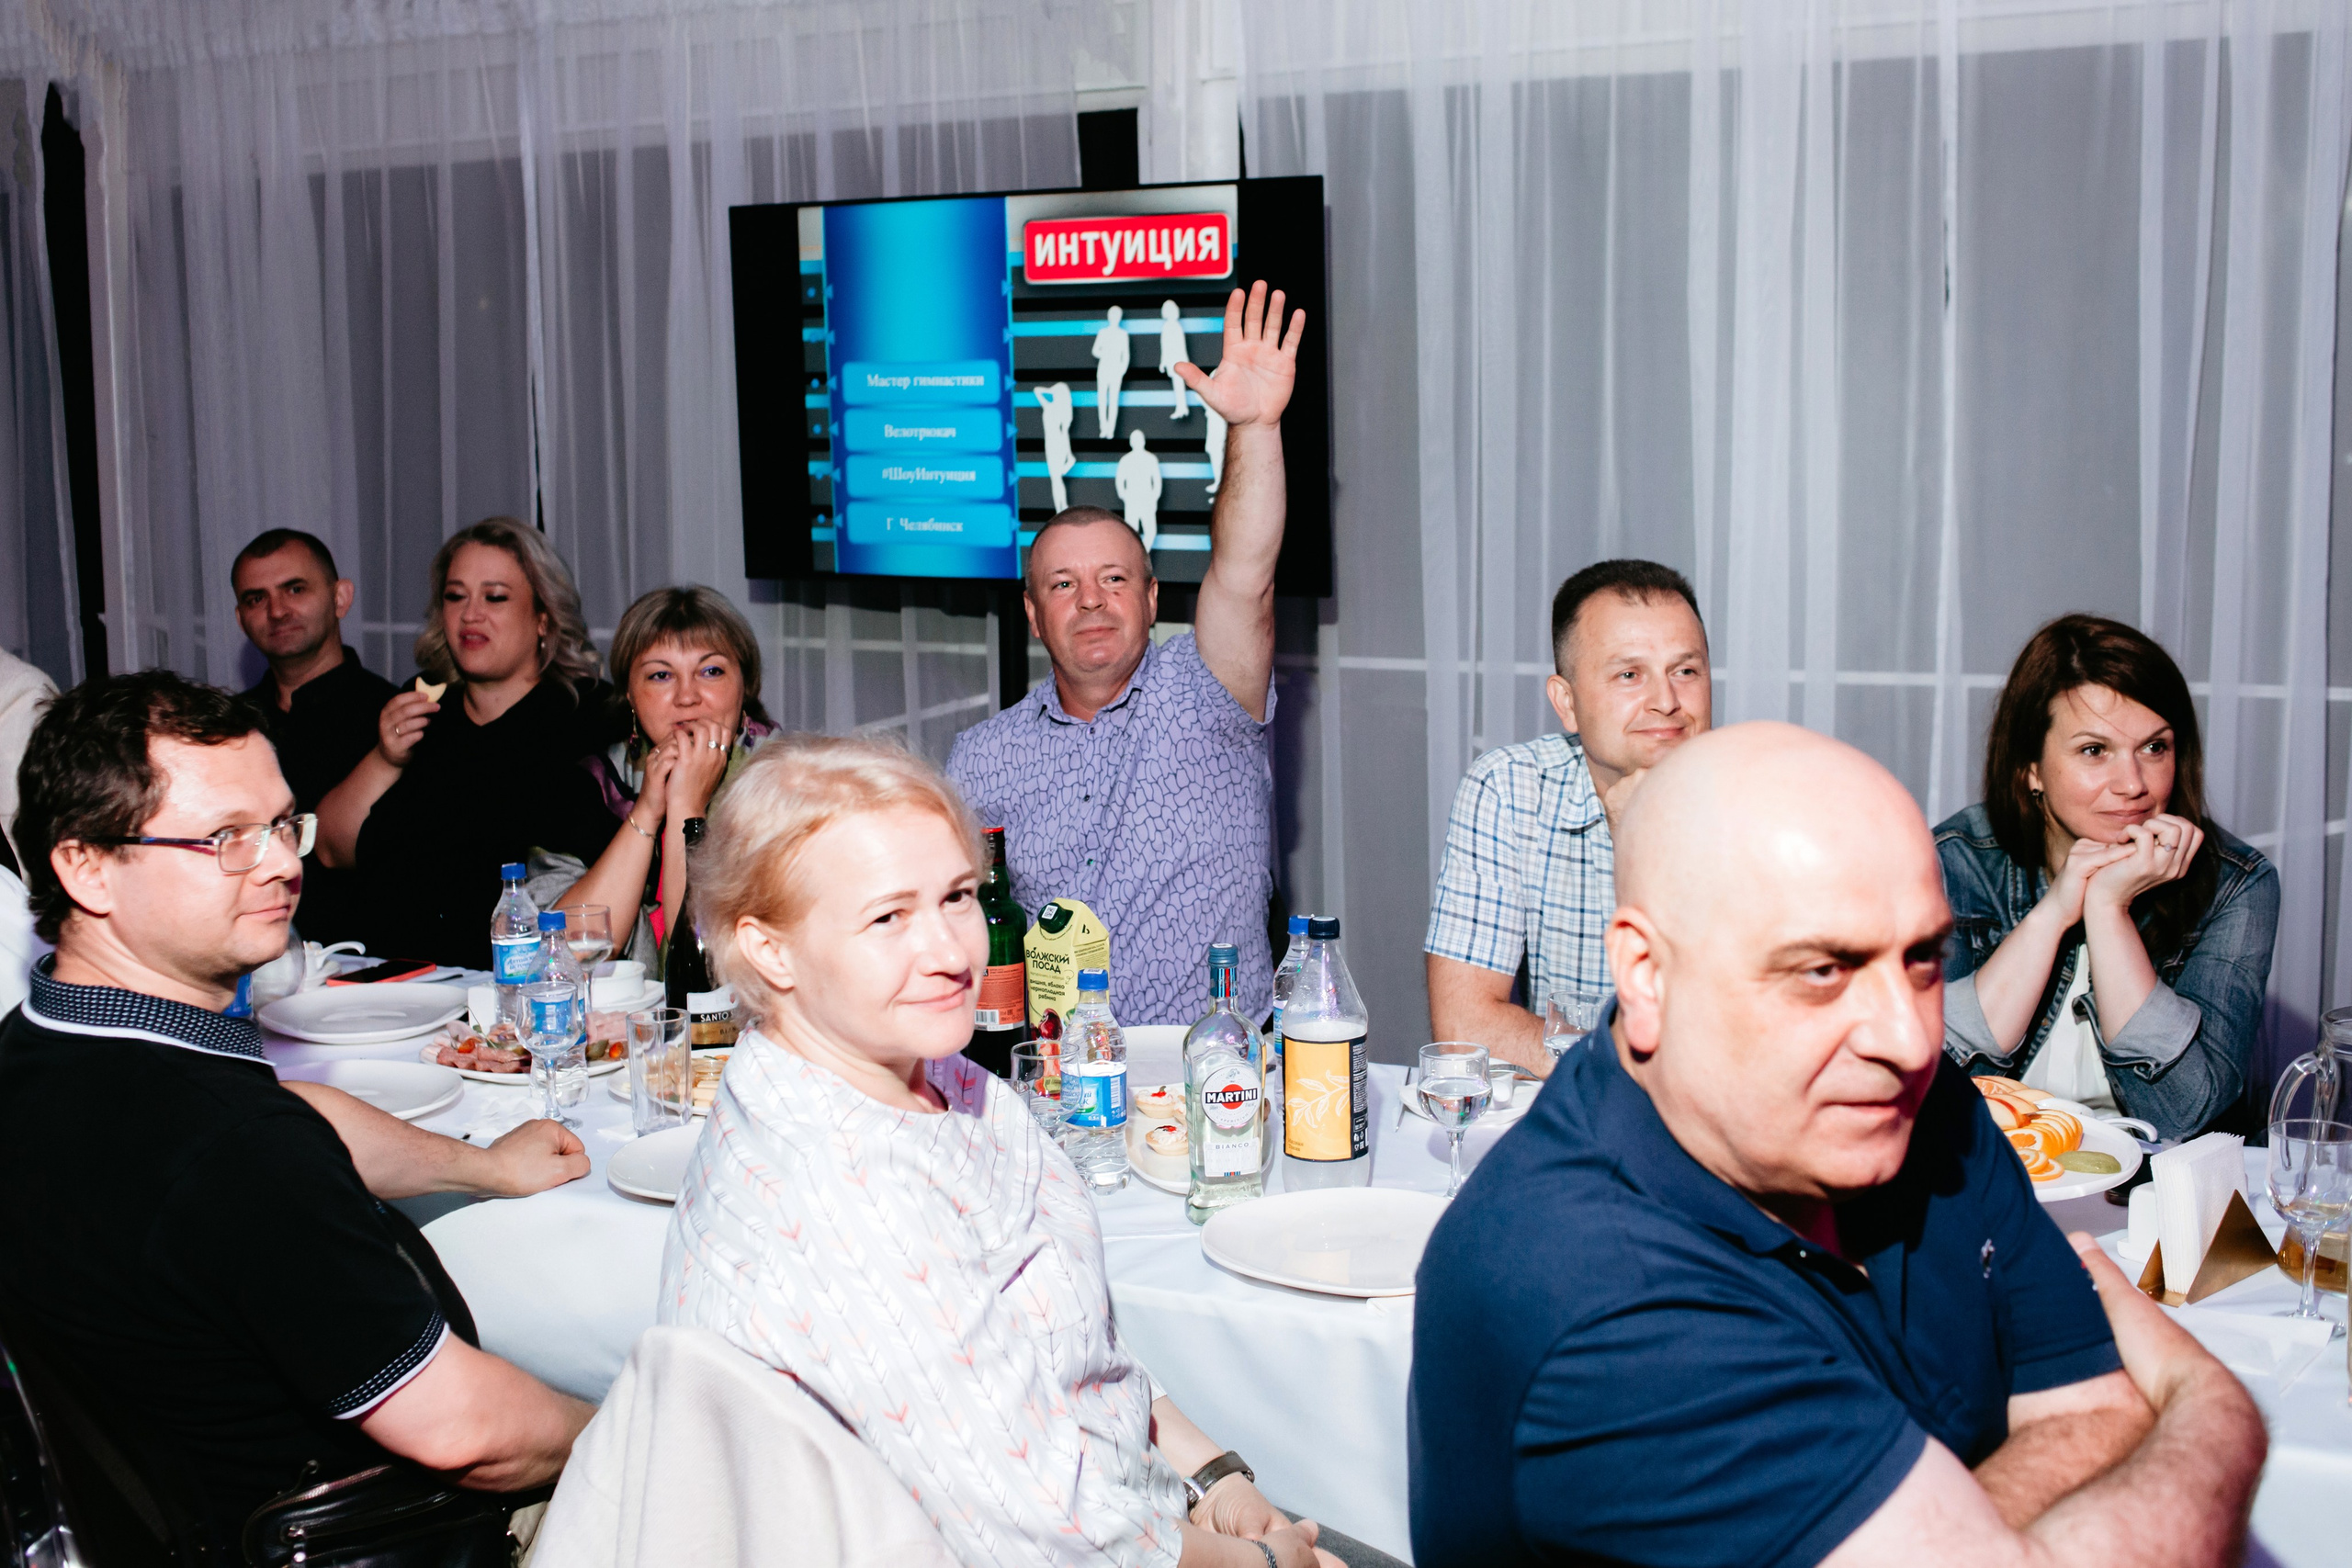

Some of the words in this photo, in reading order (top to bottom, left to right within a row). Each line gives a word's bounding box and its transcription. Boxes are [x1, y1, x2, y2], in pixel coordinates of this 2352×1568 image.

[866, 374, 910, 389] Мастер
[913, 375, 985, 387] гимнастики
[884, 423, 956, 441] Велотрюкач
[882, 467, 977, 484] #ШоуИнтуиция
[899, 517, 964, 532] Челябинск
[1032, 960, 1061, 974] ПОСАД
[700, 1011, 729, 1023] SANTO
[1205, 1089, 1257, 1103] MARTINI
[1215, 1142, 1250, 1150] BIANCO
